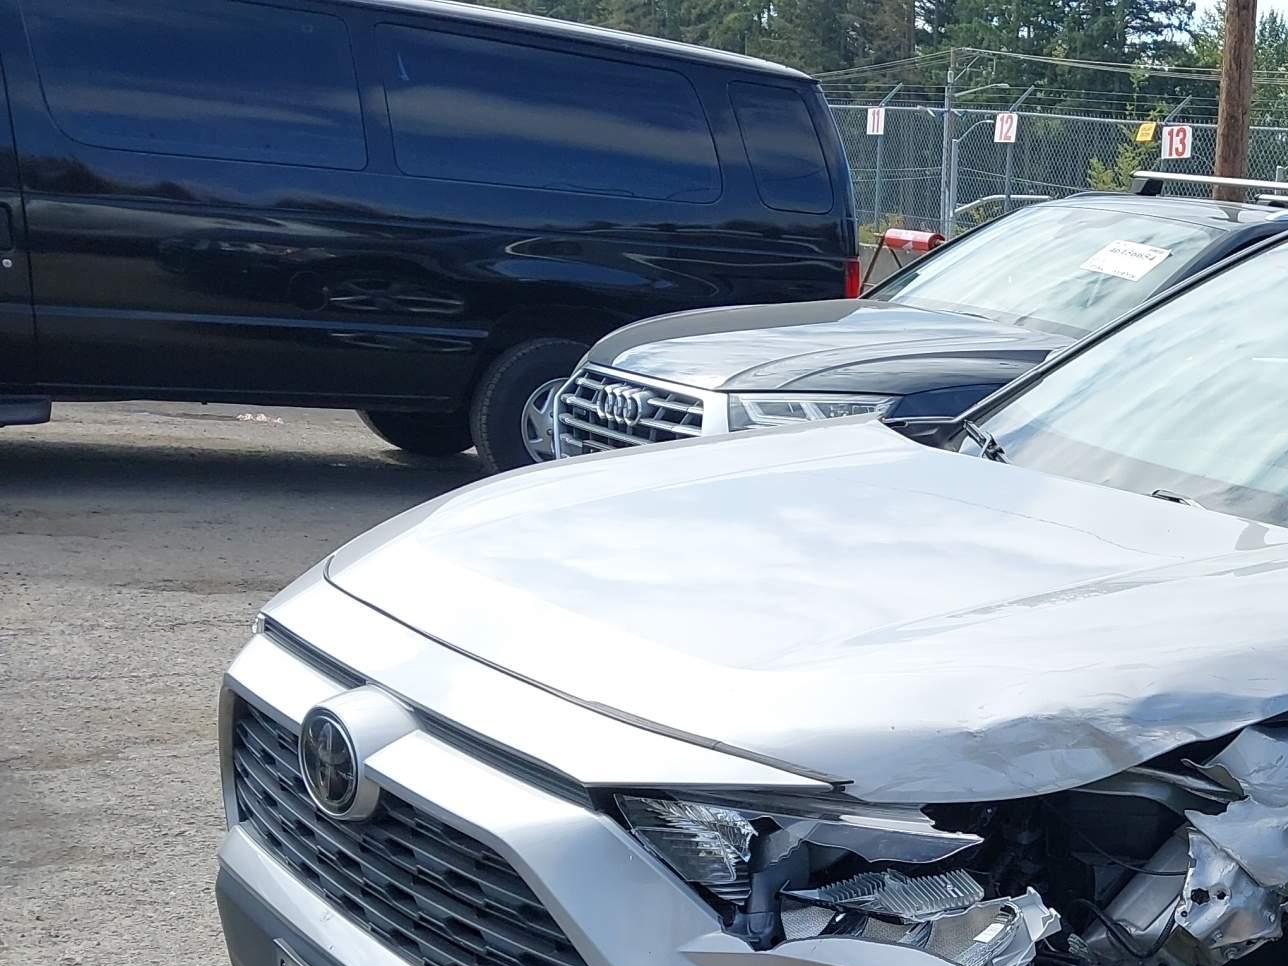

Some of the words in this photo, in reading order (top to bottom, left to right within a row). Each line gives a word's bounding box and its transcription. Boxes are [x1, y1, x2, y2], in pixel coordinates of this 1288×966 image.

[870, 108, 882, 134] 11
[997, 113, 1013, 142] 12
[1167, 127, 1187, 158] 13
